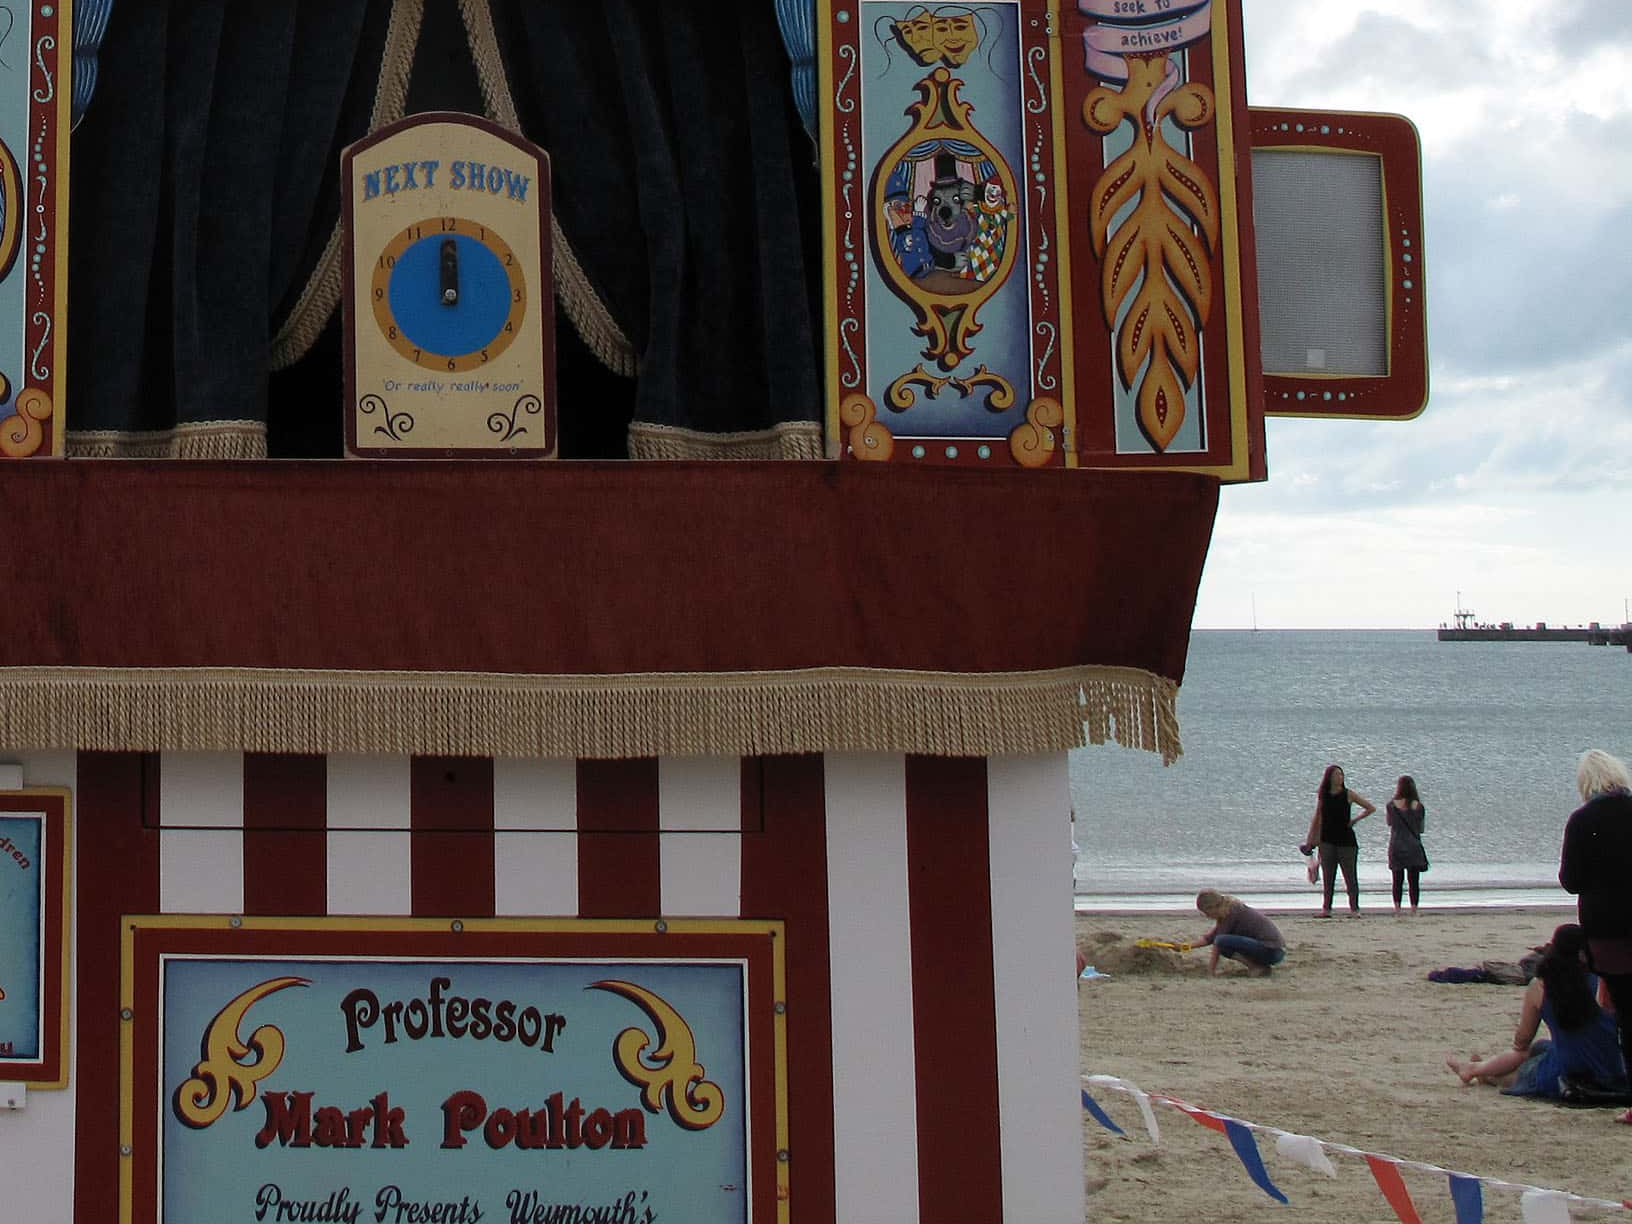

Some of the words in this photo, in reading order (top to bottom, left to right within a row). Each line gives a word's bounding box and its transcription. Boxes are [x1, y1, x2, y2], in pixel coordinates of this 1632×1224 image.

[1113, 0, 1145, 14] seek
[1121, 27, 1183, 47] achieve!
[362, 159, 440, 203] NEXT
[450, 160, 531, 203] SHOW
[442, 218, 456, 231] 12
[408, 227, 421, 239] 11
[480, 228, 485, 240] 1
[379, 256, 395, 268] 10
[506, 254, 512, 265] 2
[376, 288, 383, 301] 9
[514, 290, 520, 302] 3
[505, 322, 512, 332] 4
[389, 328, 396, 339] 8
[414, 350, 420, 362] 7
[481, 351, 488, 362] 5
[448, 359, 455, 370] 6
[340, 977, 566, 1053] Professor
[254, 1090, 410, 1150] Mark
[440, 1090, 648, 1150] Poulton
[254, 1183, 365, 1224] Proudly
[374, 1184, 485, 1224] Presents
[505, 1189, 659, 1224] Weymouth's
